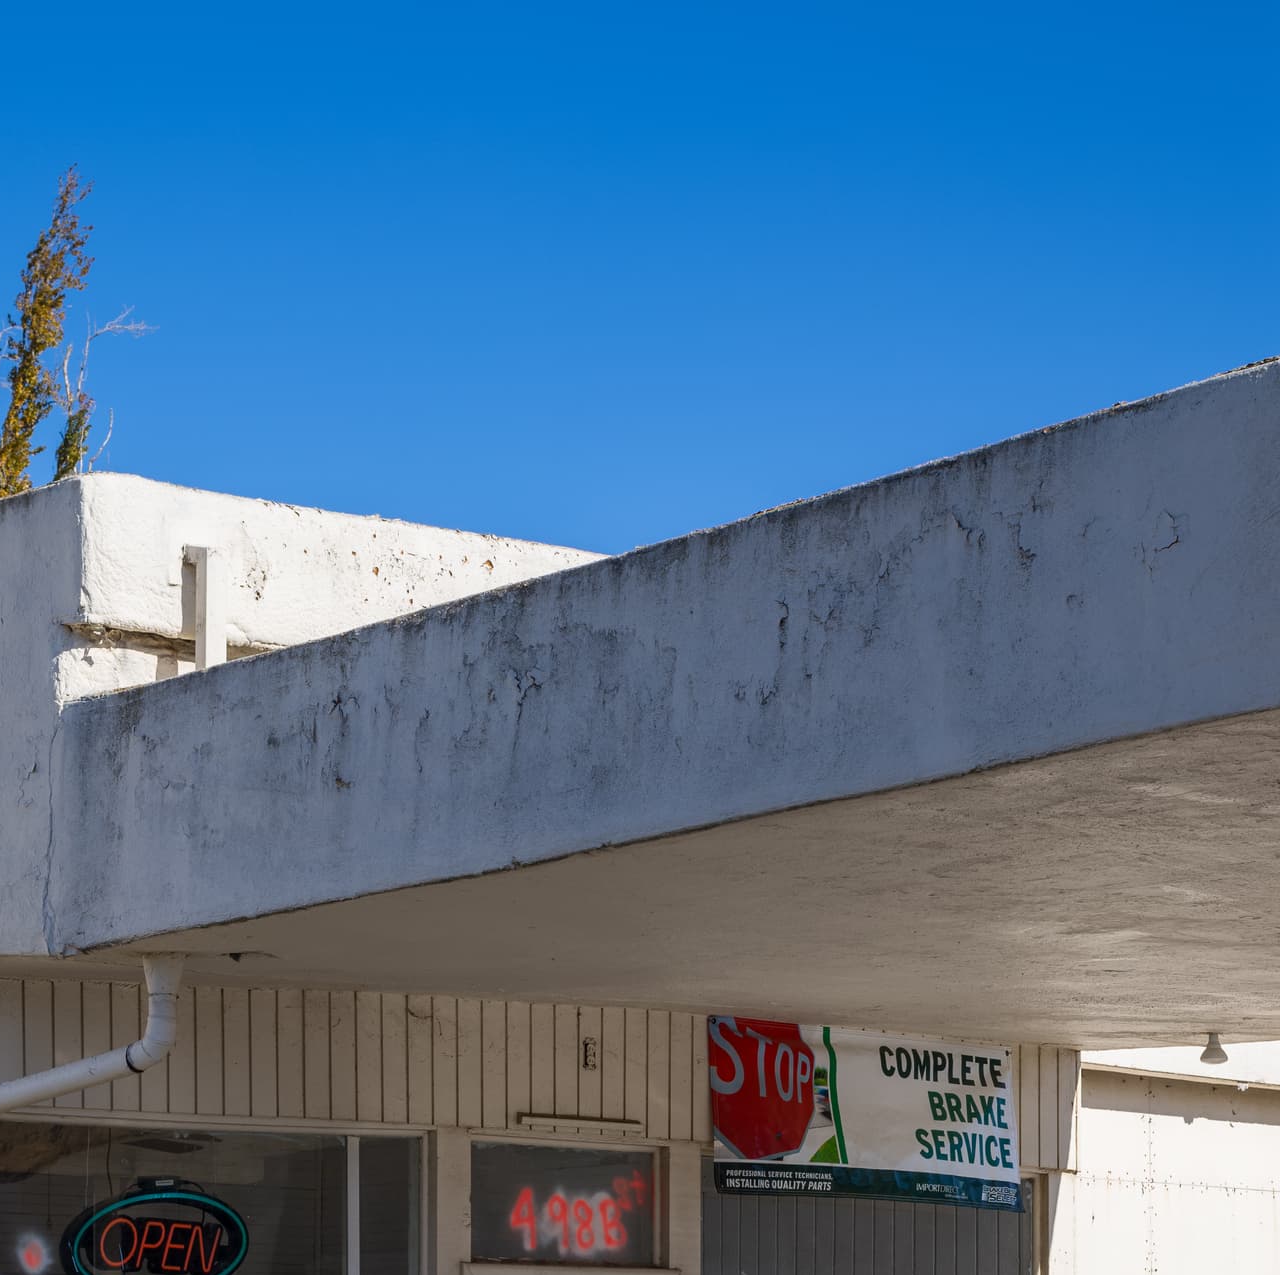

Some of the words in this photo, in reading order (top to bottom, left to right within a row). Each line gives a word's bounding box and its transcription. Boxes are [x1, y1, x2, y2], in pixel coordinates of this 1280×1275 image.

[709, 1017, 812, 1104] STOP
[878, 1044, 1007, 1089] COMPLETE
[927, 1090, 1009, 1130] BRAKE
[914, 1128, 1014, 1169] SERVICE
[725, 1169, 767, 1178] PROFESSIONAL
[767, 1170, 793, 1179] SERVICE
[725, 1177, 770, 1189] INSTALLING
[770, 1179, 806, 1190] QUALITY
[807, 1181, 833, 1192] PARTS
[100, 1217, 222, 1273] OPEN
